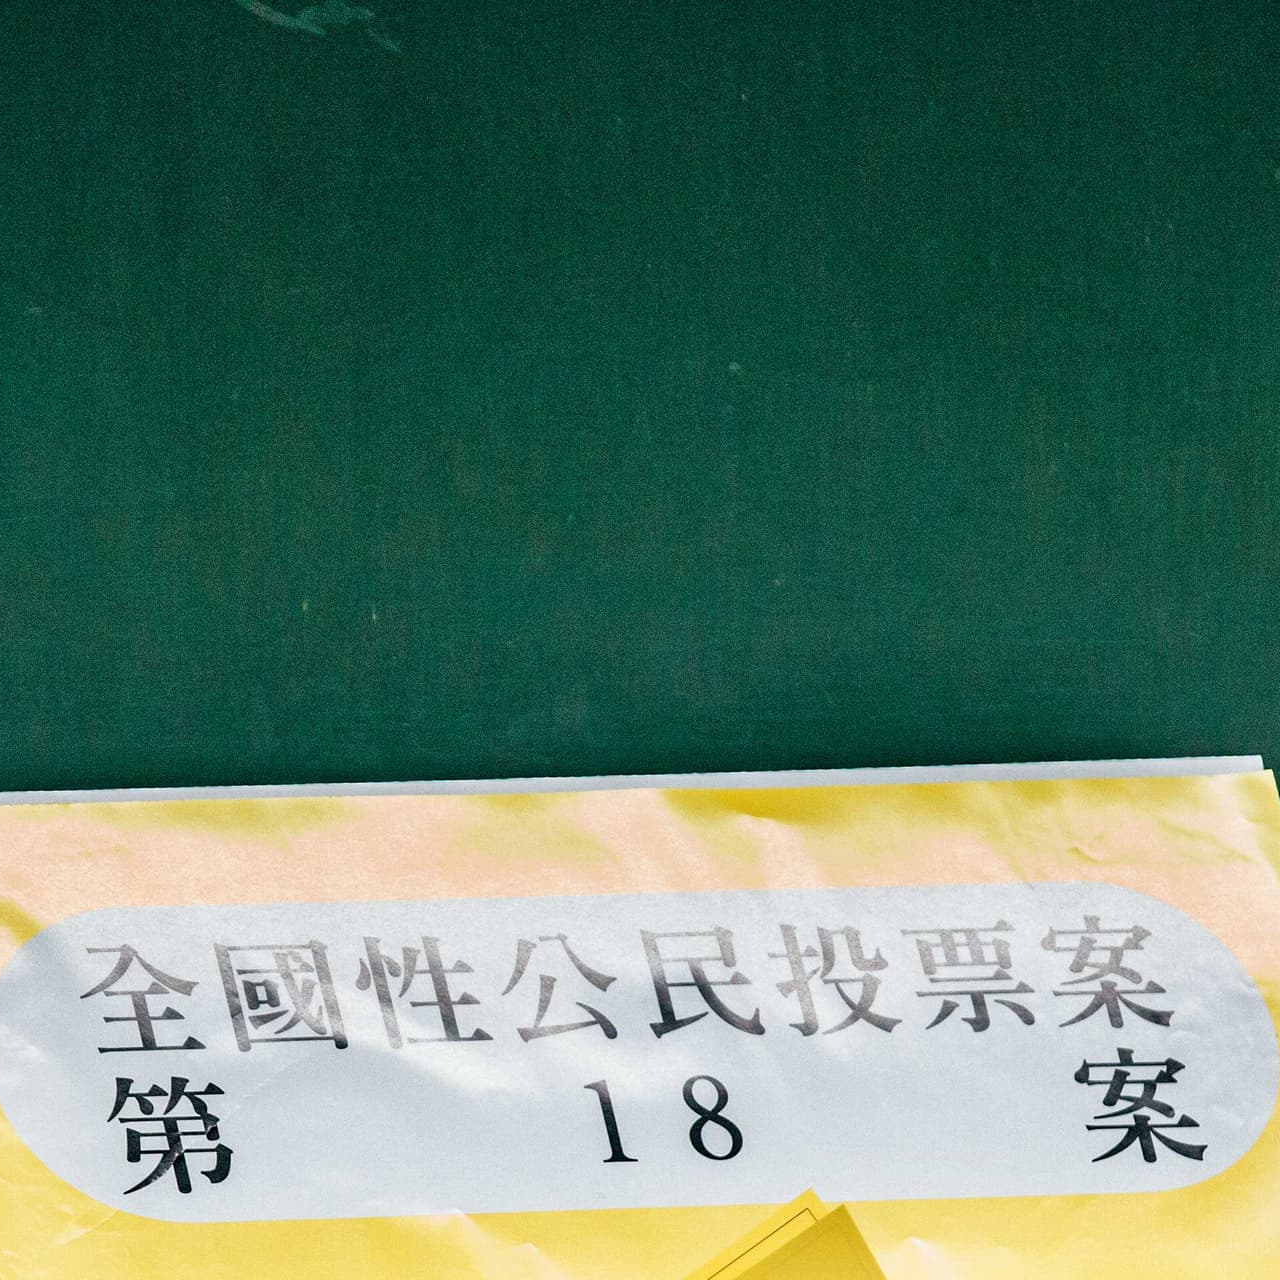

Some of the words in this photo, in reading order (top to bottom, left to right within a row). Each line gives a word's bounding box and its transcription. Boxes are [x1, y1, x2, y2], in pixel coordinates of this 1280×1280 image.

[79, 915, 1175, 1055] 全國性公民投票案
[107, 1075, 234, 1195] 第
[594, 1074, 744, 1164] 18
[1073, 1047, 1208, 1164] 案
